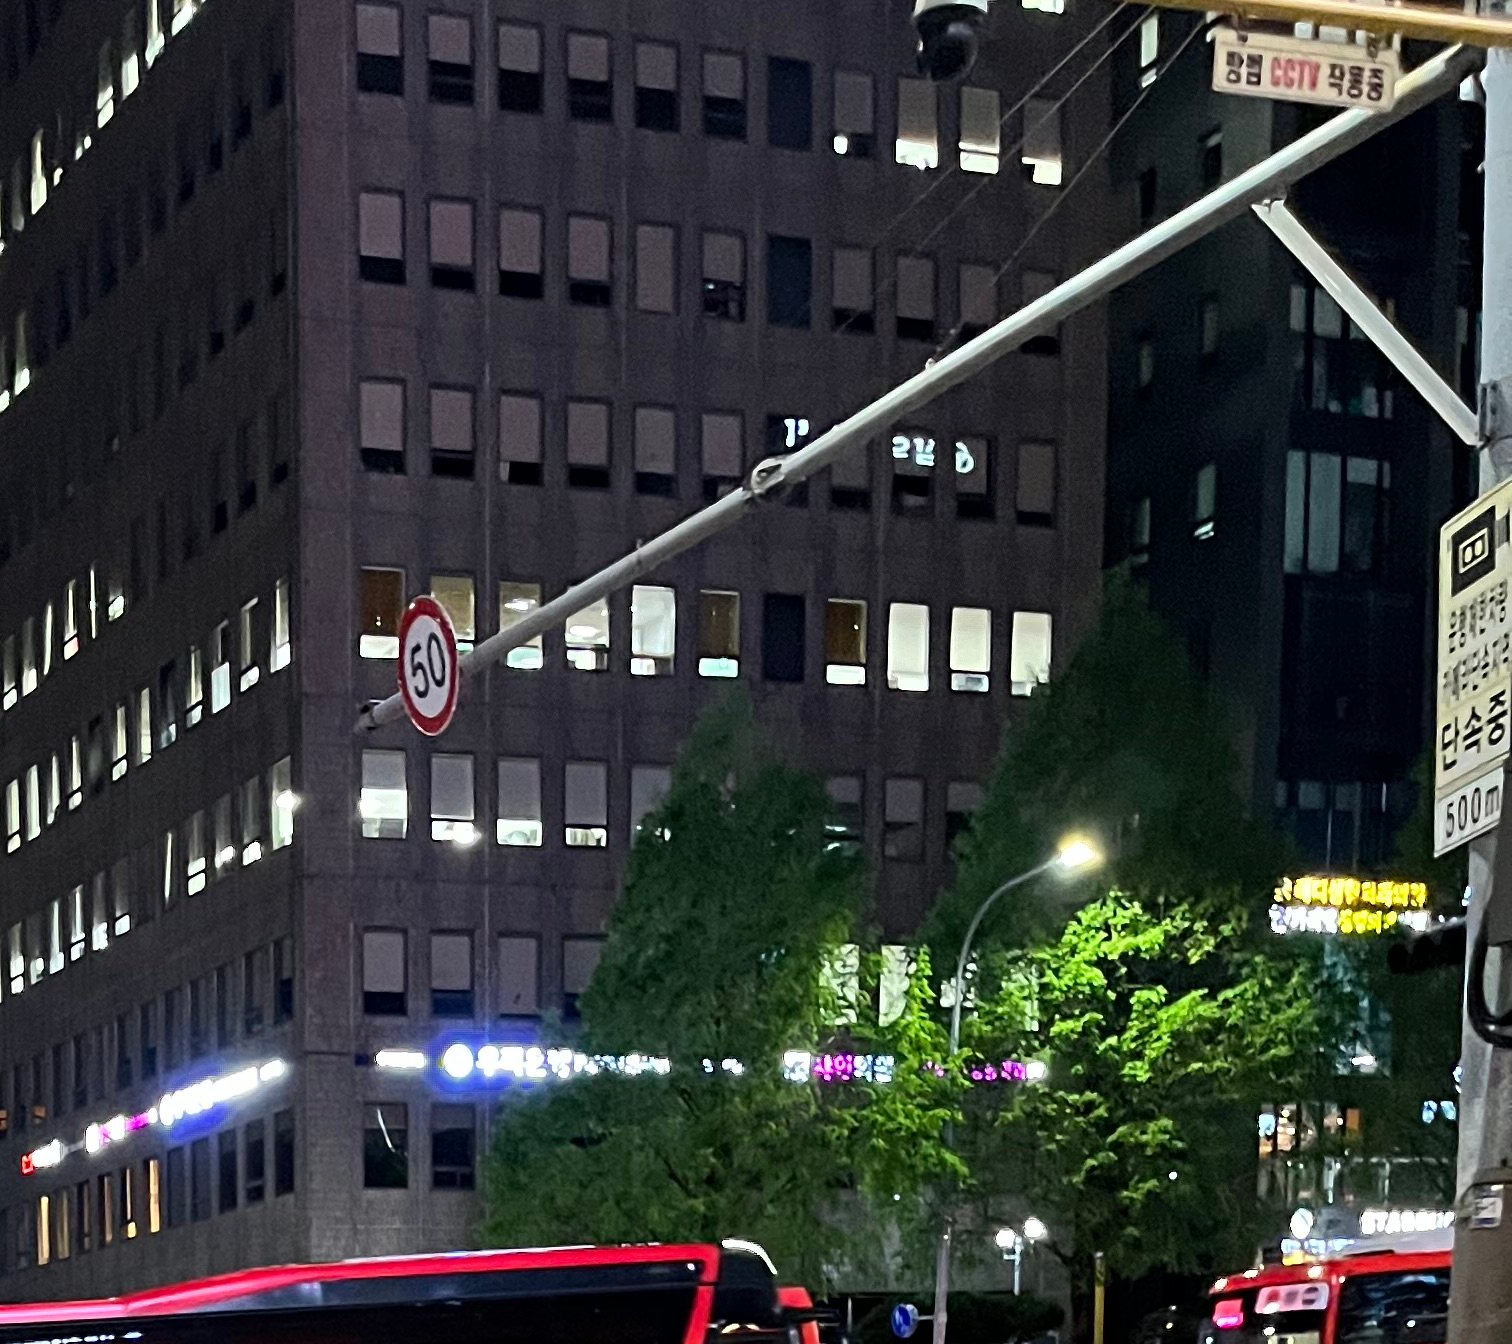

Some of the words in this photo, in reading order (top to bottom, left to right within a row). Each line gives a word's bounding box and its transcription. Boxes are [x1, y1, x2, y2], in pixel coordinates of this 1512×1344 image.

[1226, 51, 1265, 87] 방범
[1270, 57, 1321, 92] CCTV
[1328, 63, 1385, 101] 작동중
[410, 631, 446, 699] 50
[1441, 688, 1509, 772] 단속중
[1445, 784, 1501, 839] 500m
